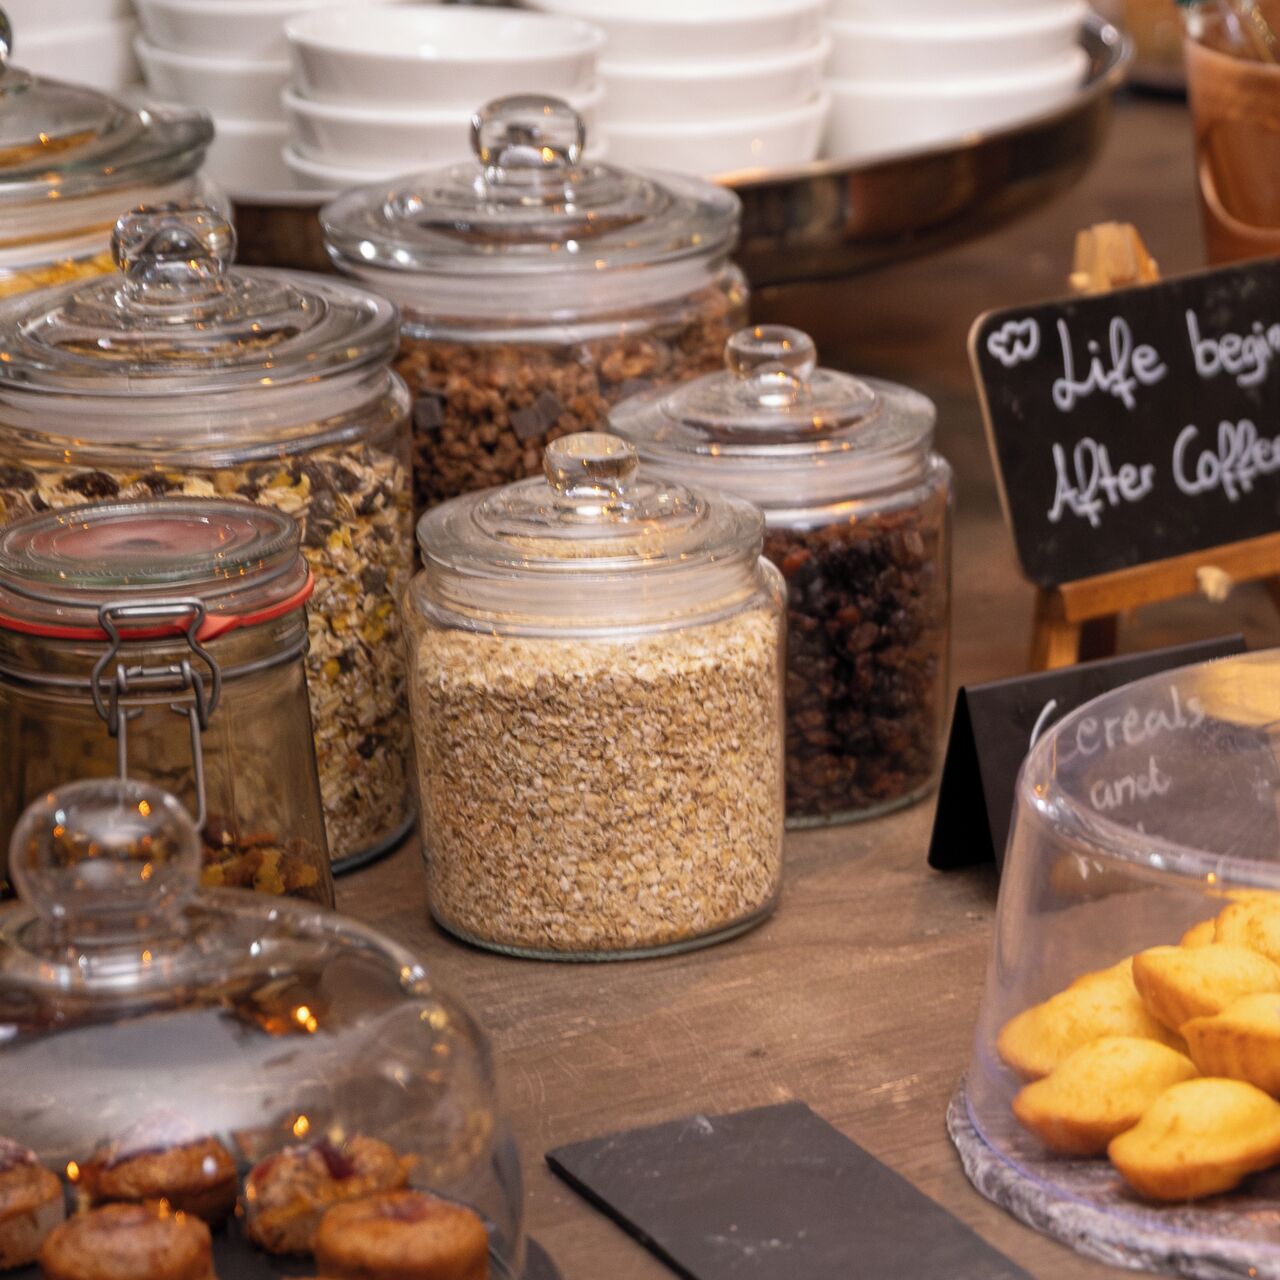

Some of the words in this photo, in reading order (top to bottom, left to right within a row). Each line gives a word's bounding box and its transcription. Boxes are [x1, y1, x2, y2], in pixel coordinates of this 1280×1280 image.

[1053, 316, 1167, 410] Life
[1047, 437, 1155, 527] After
[1090, 756, 1172, 811] and
